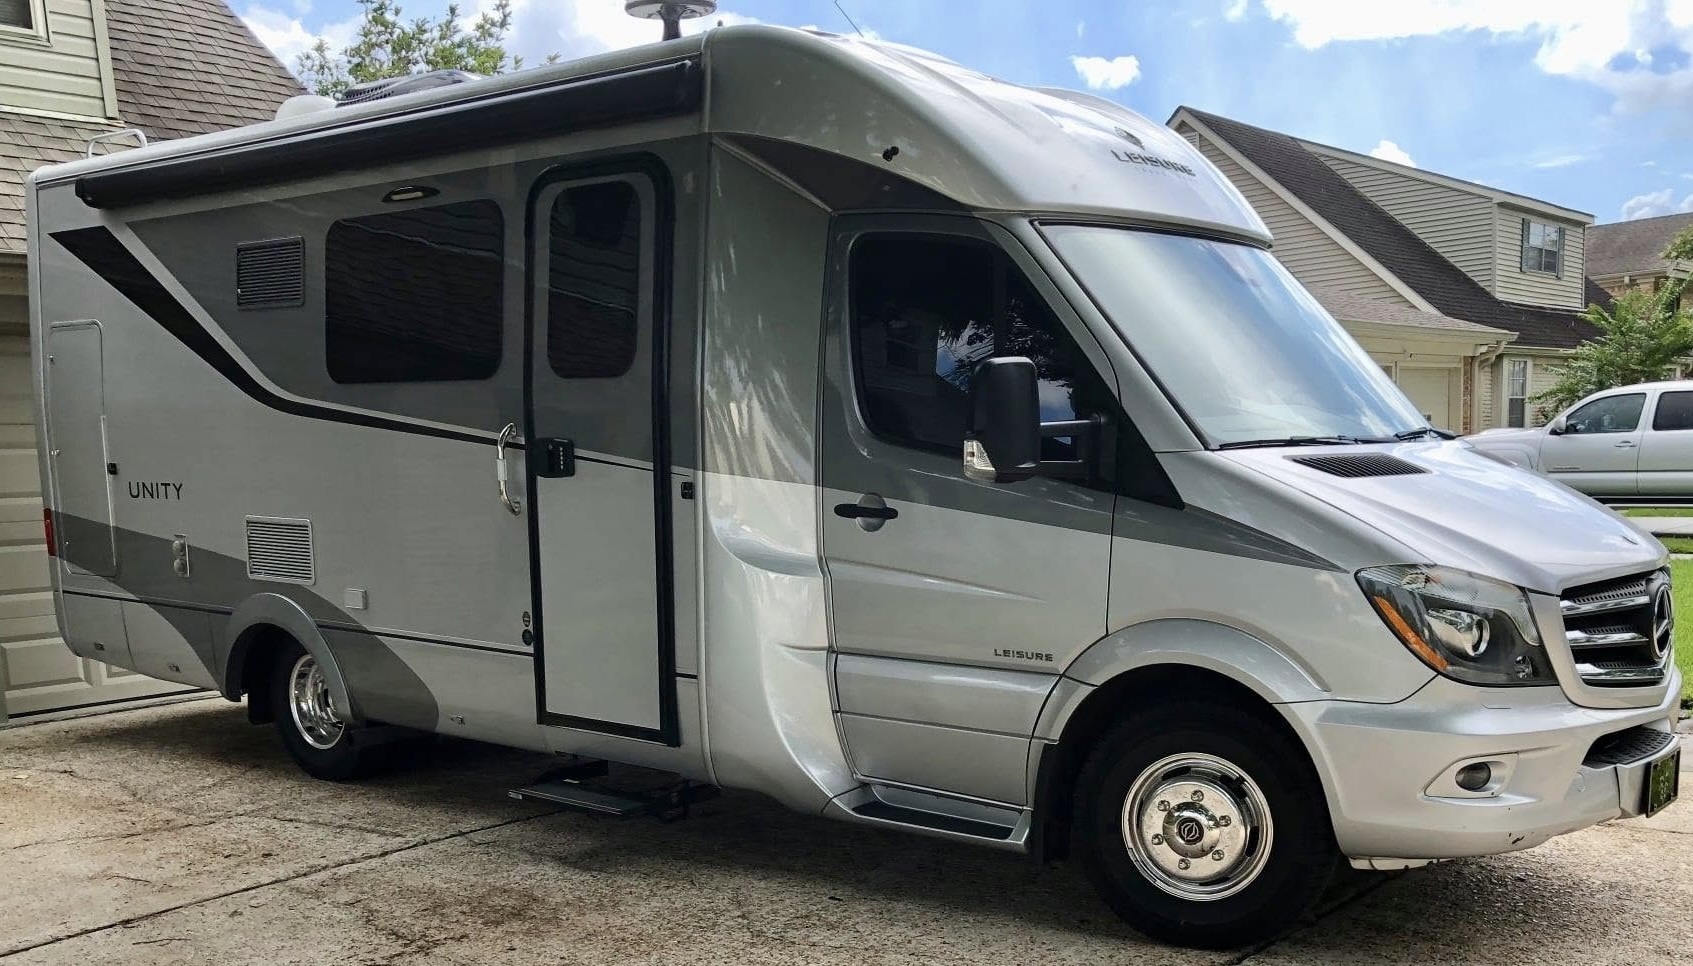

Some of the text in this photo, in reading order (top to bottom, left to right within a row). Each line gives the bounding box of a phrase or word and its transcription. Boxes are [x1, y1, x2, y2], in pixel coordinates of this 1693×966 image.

[1110, 149, 1196, 176] LEISURE
[128, 481, 183, 500] UNITY
[993, 648, 1054, 662] LEISURE
